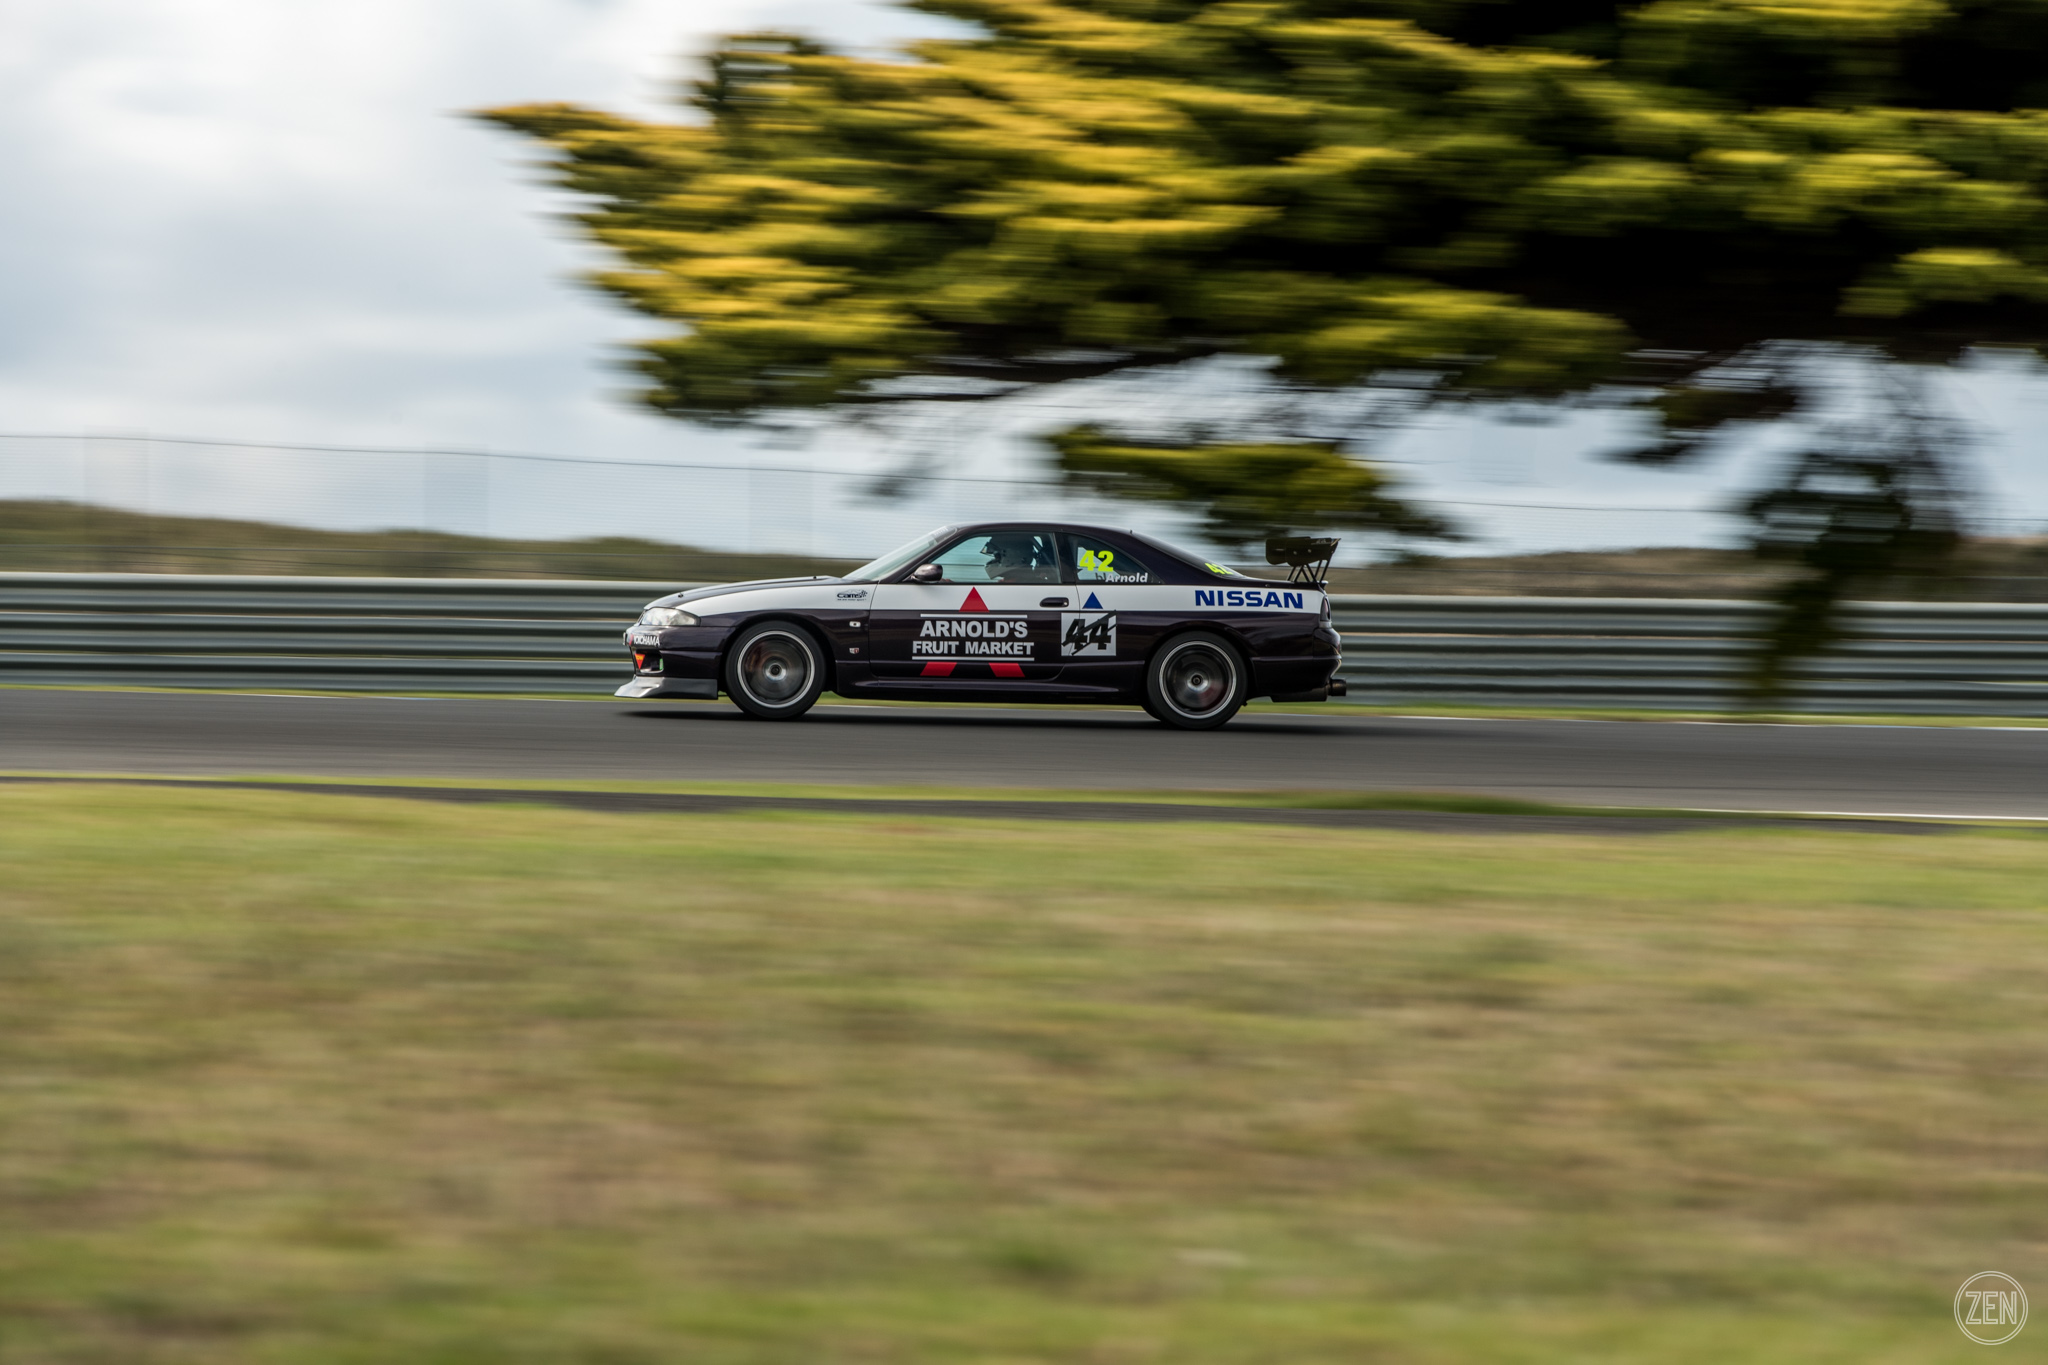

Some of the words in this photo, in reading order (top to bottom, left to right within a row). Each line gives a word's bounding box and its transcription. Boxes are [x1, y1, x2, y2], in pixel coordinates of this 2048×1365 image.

[1079, 549, 1114, 572] 42
[1105, 572, 1148, 583] Arnold
[1195, 590, 1304, 610] NISSAN
[920, 620, 1028, 638] ARNOLD'S
[1065, 618, 1112, 651] 44
[912, 640, 960, 654] FRUIT
[965, 641, 1035, 655] MARKET
